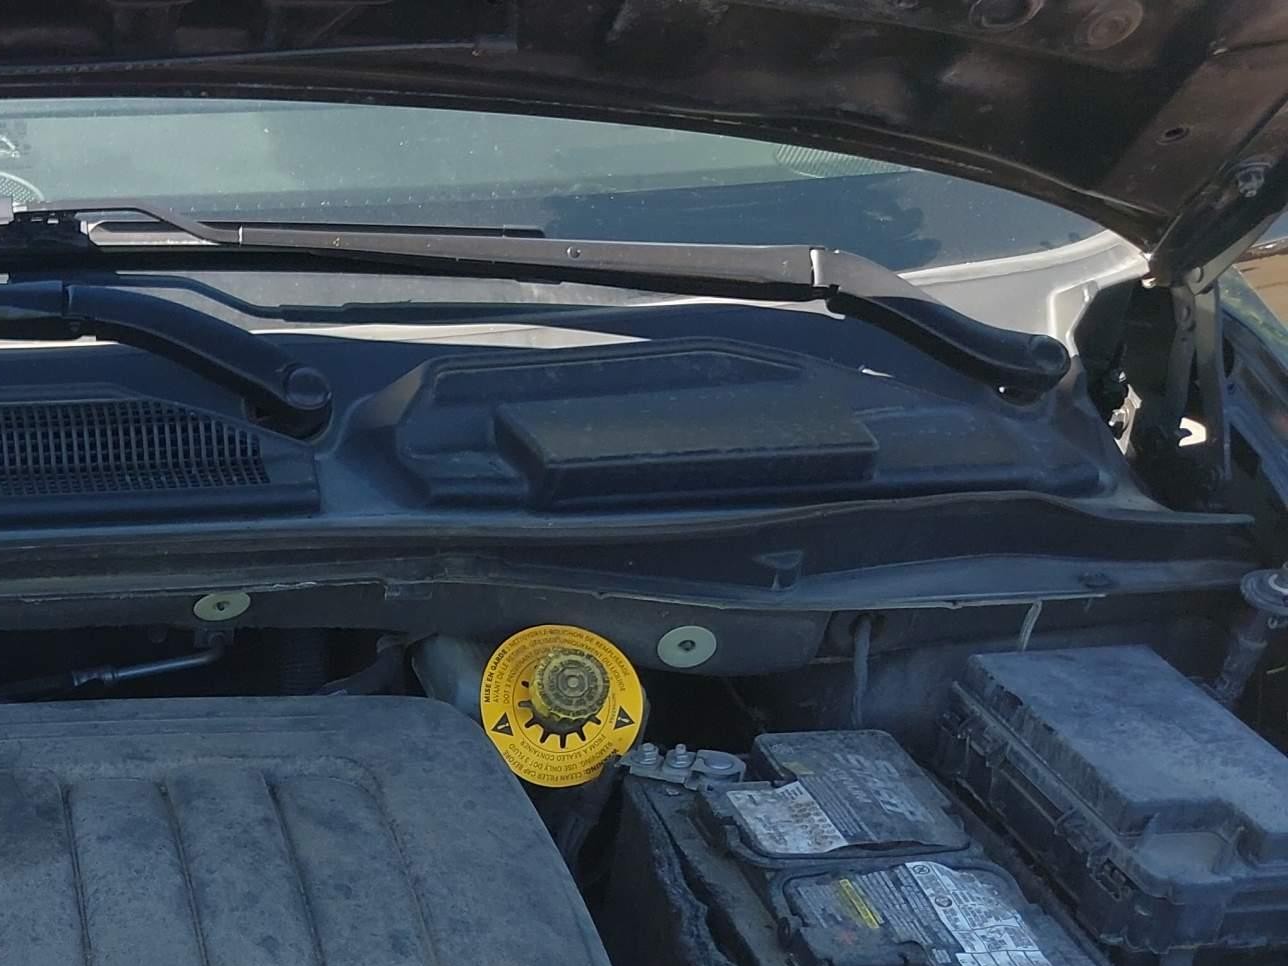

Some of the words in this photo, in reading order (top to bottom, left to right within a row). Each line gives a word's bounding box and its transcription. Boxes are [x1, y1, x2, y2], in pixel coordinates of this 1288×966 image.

[487, 671, 494, 682] EN
[596, 640, 630, 677] REMPLISSAGE
[557, 751, 582, 762] SEALED
[529, 760, 543, 770] DOT
[564, 763, 577, 772] USE
[524, 768, 536, 777] CAP
[560, 772, 582, 782] CLEAN
